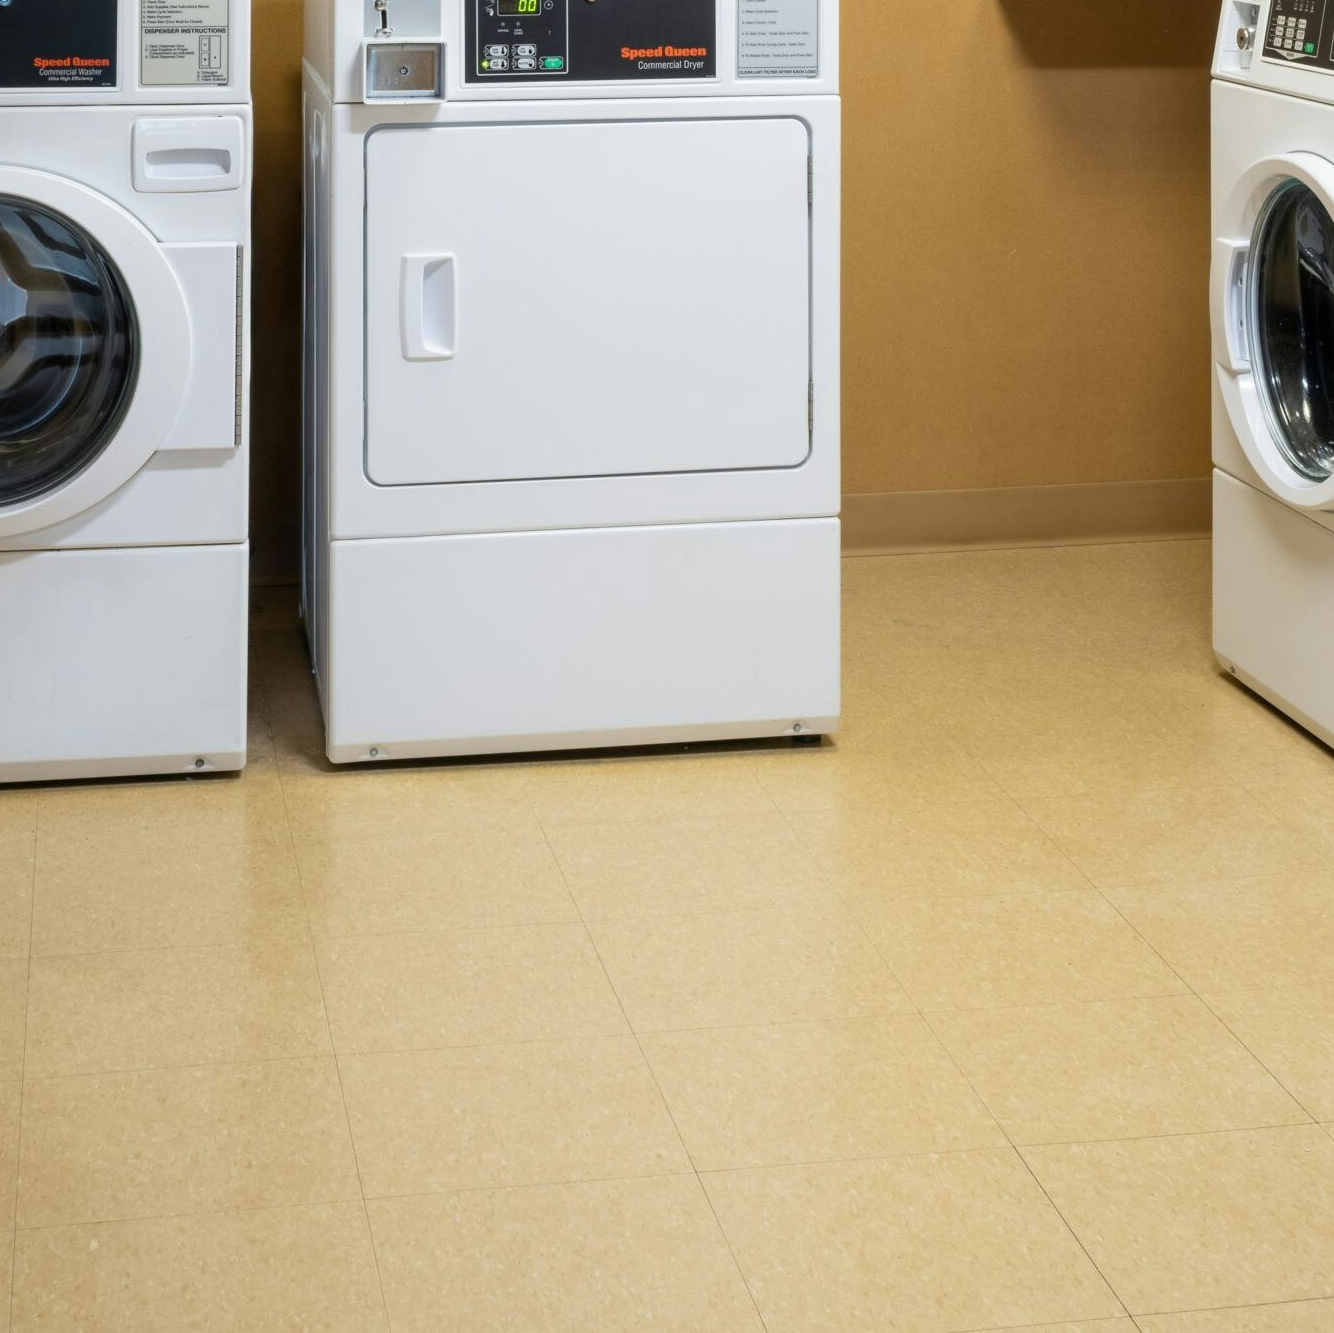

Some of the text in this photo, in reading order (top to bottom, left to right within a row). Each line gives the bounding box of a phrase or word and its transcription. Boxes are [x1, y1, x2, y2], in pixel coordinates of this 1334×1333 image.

[518, 0, 537, 12] 00
[620, 45, 707, 60] Speed Queen
[33, 56, 110, 68] Speed Queen
[638, 60, 705, 70] Commercial Dryer
[39, 68, 102, 76] Commercial Washer
